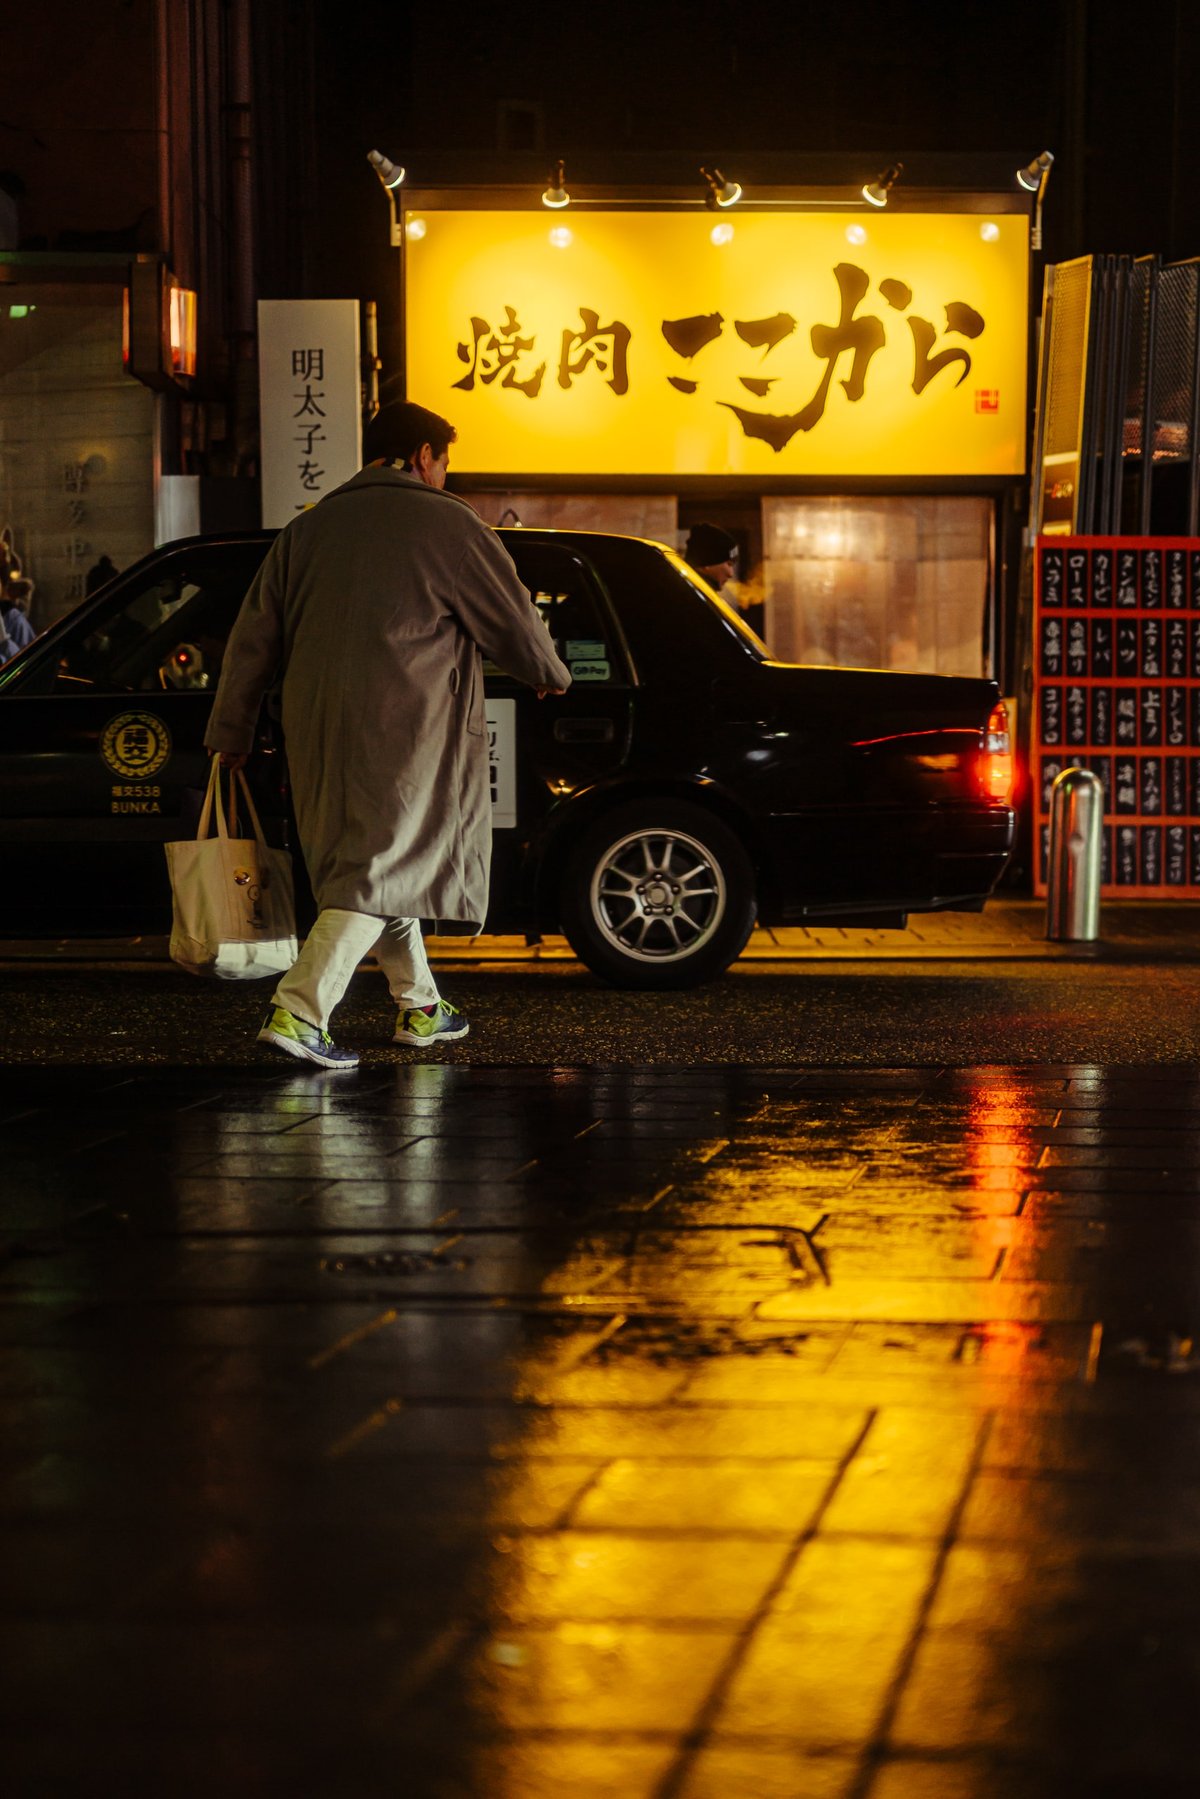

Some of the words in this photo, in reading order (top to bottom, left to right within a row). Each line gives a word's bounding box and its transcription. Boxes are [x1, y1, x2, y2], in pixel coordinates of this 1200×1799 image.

[452, 306, 632, 398] 焼肉
[291, 348, 327, 510] 明太子を
[1046, 556, 1061, 602] ハラミ
[1069, 555, 1085, 602] ロース
[1095, 555, 1111, 602] カルビ
[1120, 630, 1136, 662] ハツ
[1142, 689, 1160, 739] 上ミノ
[112, 802, 161, 813] BUNKA
